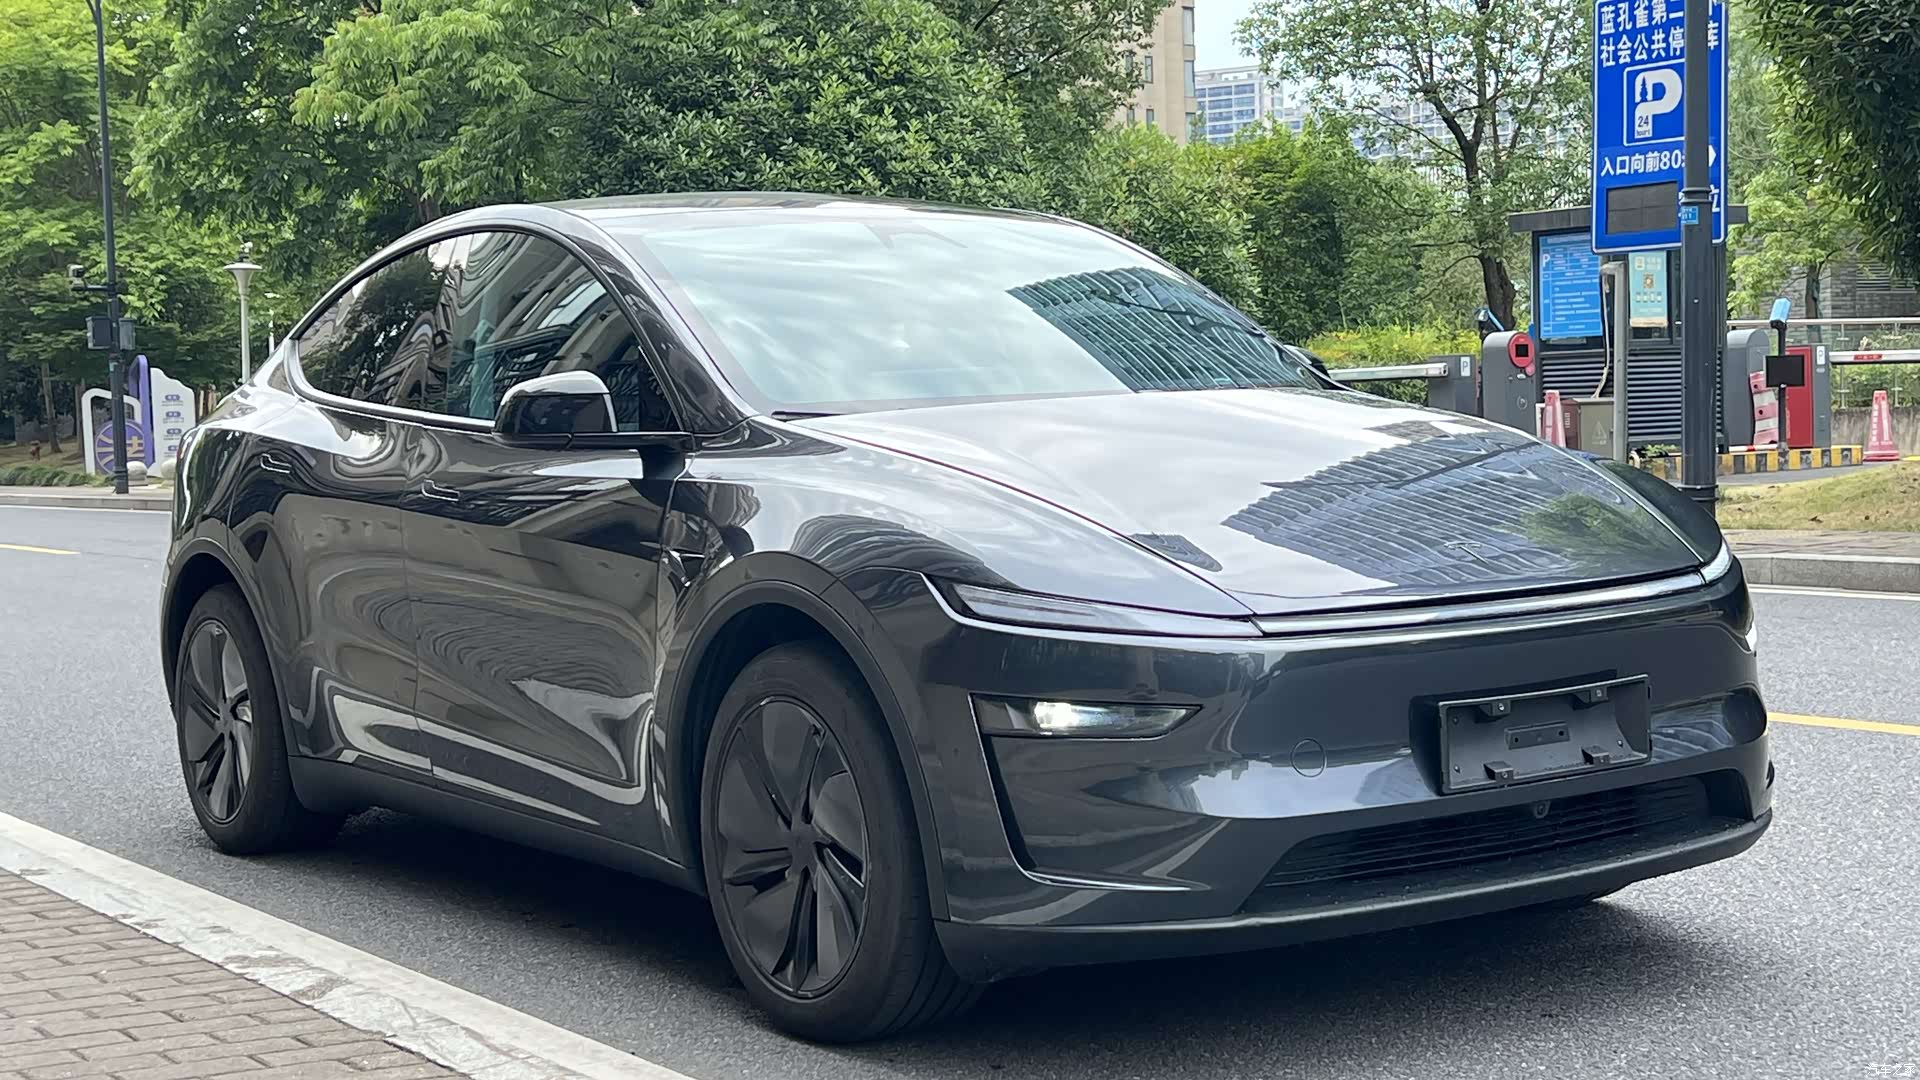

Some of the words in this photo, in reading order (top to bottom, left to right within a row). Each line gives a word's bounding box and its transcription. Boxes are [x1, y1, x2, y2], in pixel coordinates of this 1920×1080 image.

[1637, 115, 1649, 128] 24
[1600, 149, 1685, 177] 入口向前80
[1542, 253, 1551, 268] P
[1462, 360, 1469, 373] P
